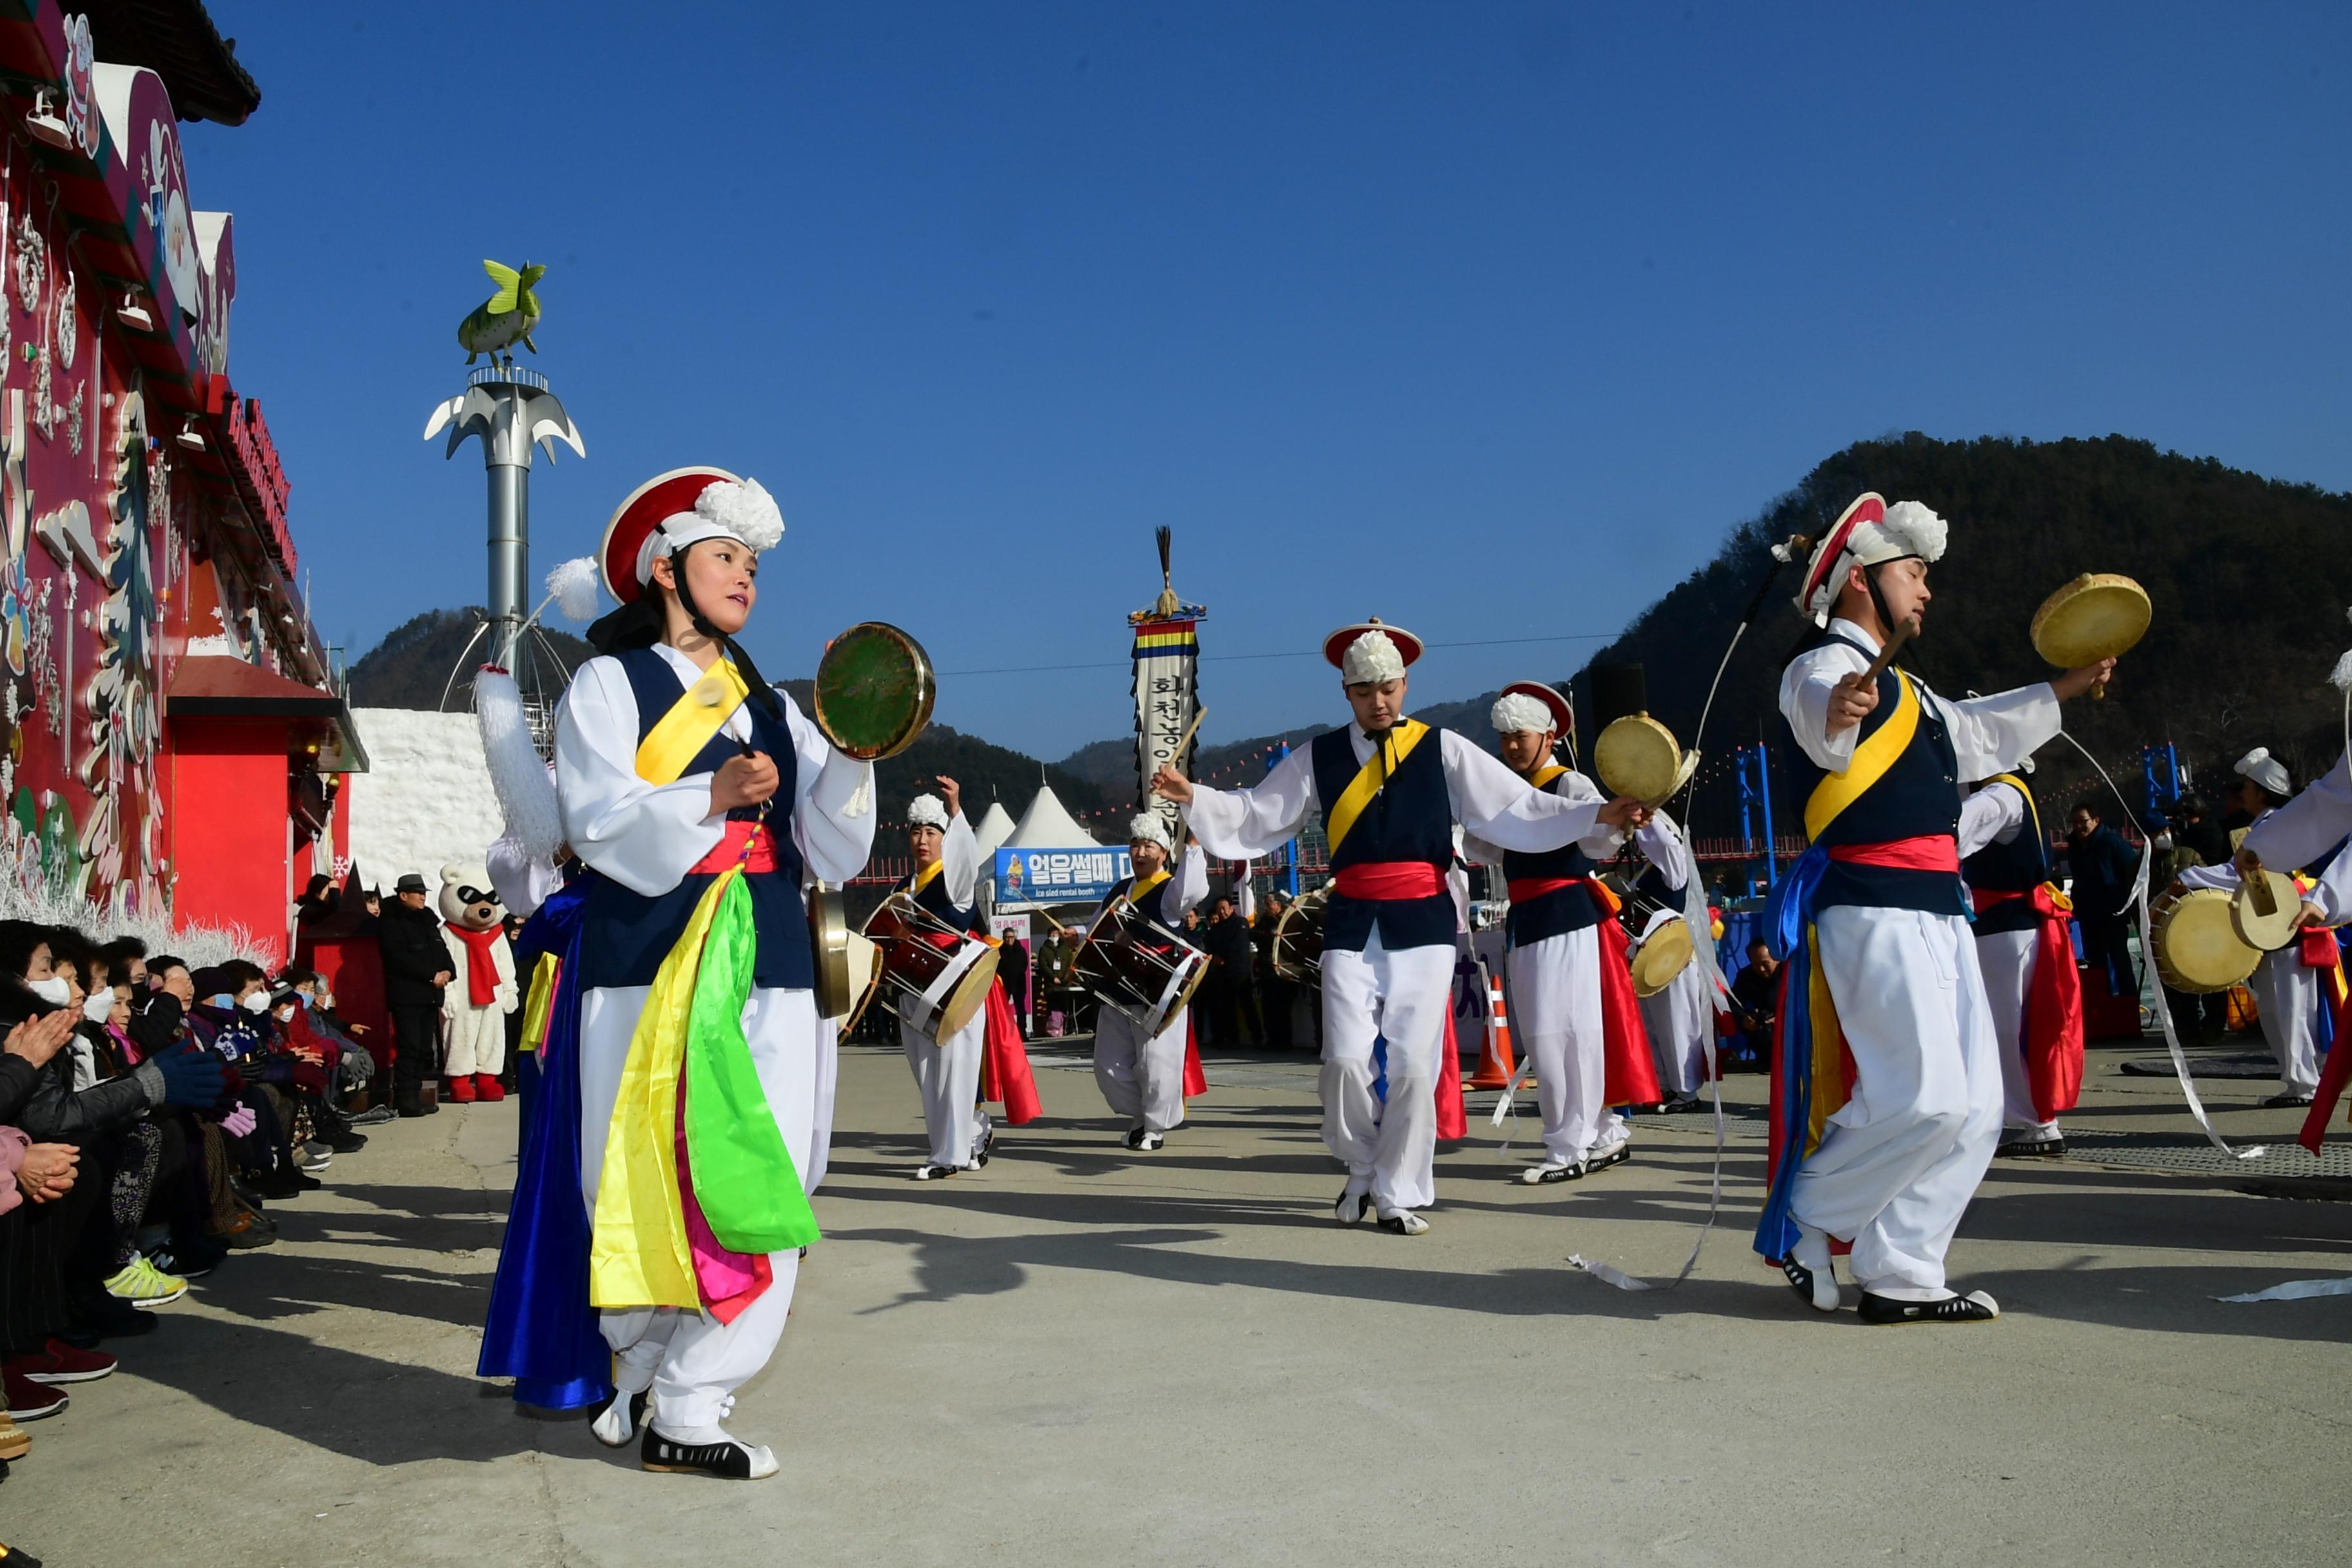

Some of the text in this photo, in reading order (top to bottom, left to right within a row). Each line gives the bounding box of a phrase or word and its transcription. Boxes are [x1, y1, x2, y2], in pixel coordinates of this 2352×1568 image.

[1028, 853, 1113, 885] 얼음썰매
[1045, 888, 1059, 897] sled
[1059, 888, 1077, 896] rental
[1078, 887, 1095, 896] booth
